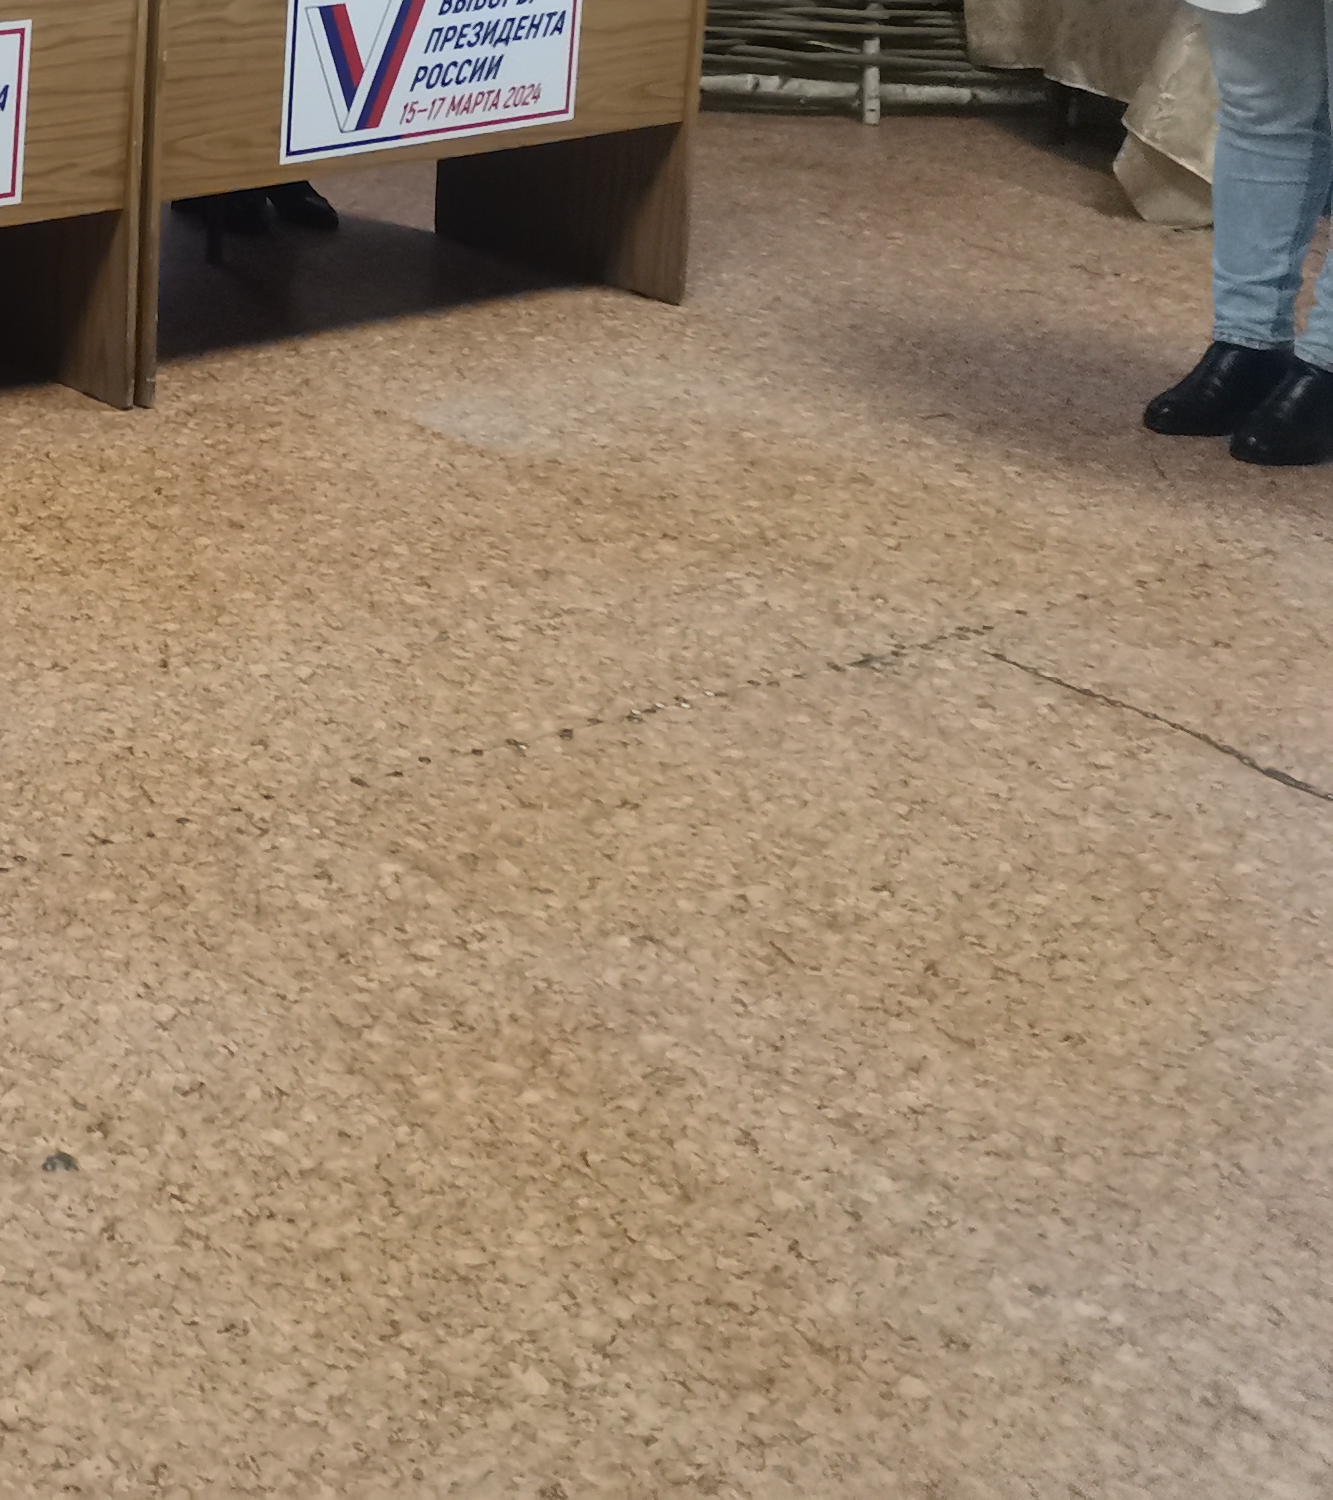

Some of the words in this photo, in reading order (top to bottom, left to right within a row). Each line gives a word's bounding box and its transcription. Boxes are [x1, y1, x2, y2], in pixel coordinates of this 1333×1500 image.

[424, 10, 566, 54] ПРЕЗИДЕНТА
[410, 54, 504, 91] РОССИИ
[447, 90, 502, 117] МАРТА
[503, 82, 543, 111] 2024
